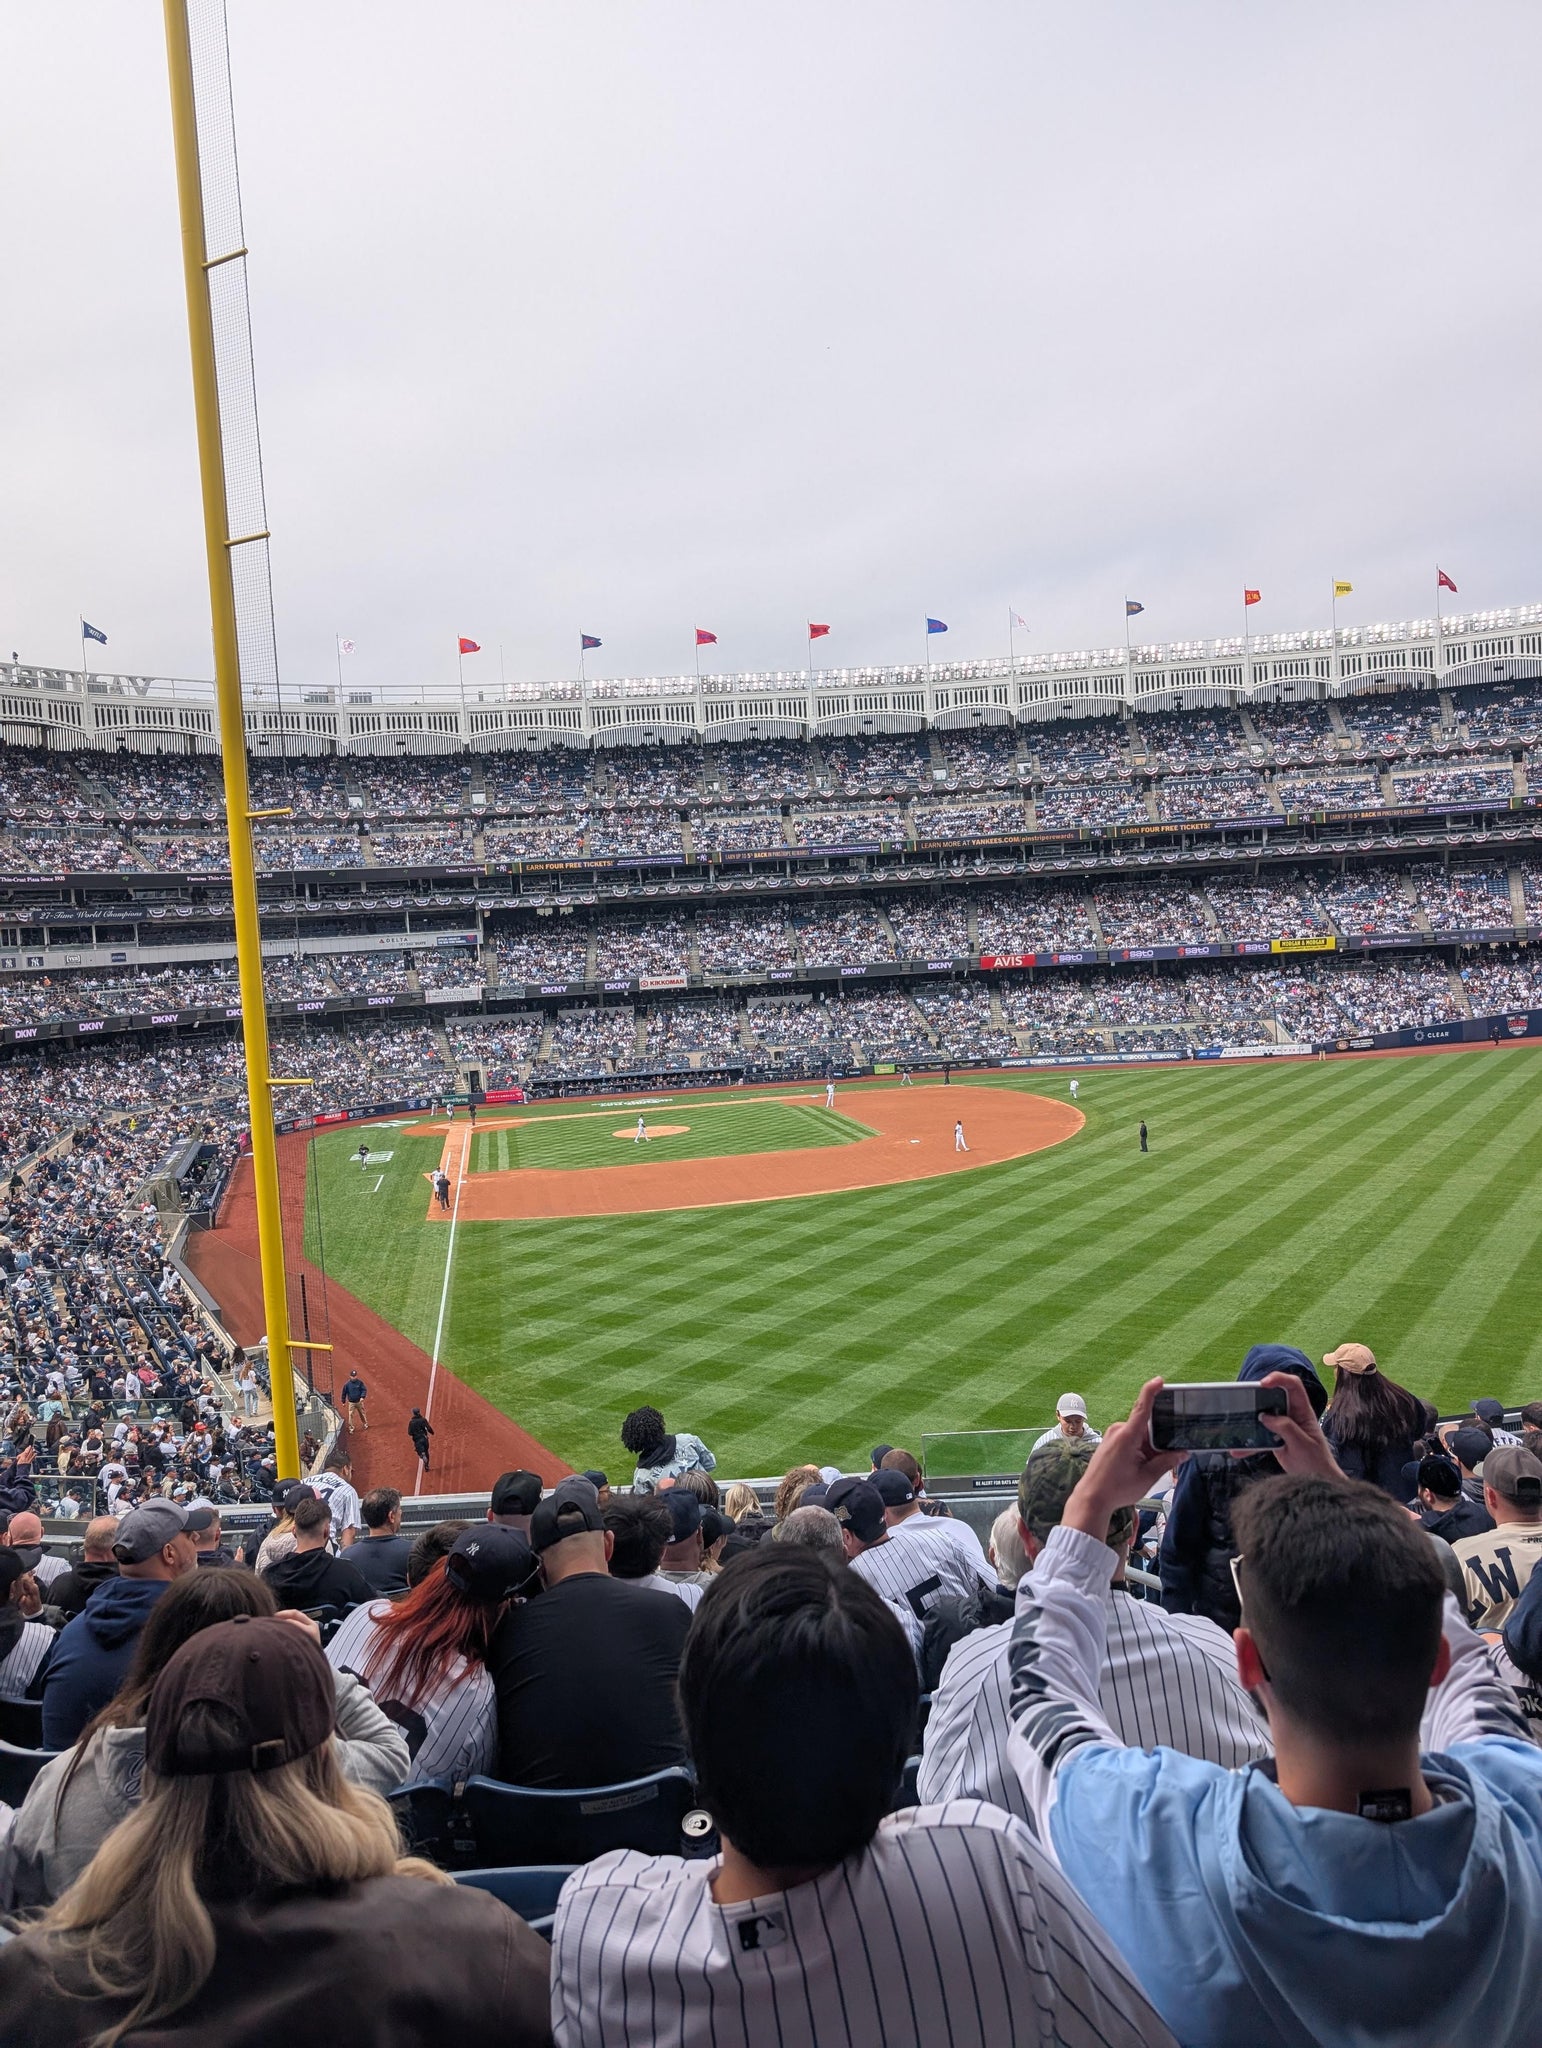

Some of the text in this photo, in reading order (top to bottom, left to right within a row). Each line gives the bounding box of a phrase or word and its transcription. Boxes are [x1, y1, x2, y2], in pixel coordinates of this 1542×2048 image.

[1171, 780, 1248, 792] ASPEN VODKA
[1050, 788, 1127, 800] ASPEN VODKA
[1180, 823, 1211, 831] TICKETS!
[921, 841, 942, 849] LEARN
[583, 860, 613, 868] TICKETS!
[39, 908, 143, 920] 27-Time World Champions
[1370, 937, 1394, 945] Benjamin
[927, 961, 953, 970] DKNY
[994, 956, 1023, 967] AVIS
[771, 971, 793, 979] DKNY
[841, 966, 867, 976] DKNY
[604, 981, 631, 990] DKNY
[649, 978, 685, 987] KIKKOMAN
[541, 985, 568, 994] DKNY
[367, 996, 396, 1006] DKNY
[297, 1001, 326, 1011] DKNY
[226, 1009, 243, 1018] DK
[151, 1014, 179, 1024] DKNY
[78, 1022, 105, 1032] DKNY
[15, 1028, 38, 1039] DKNY
